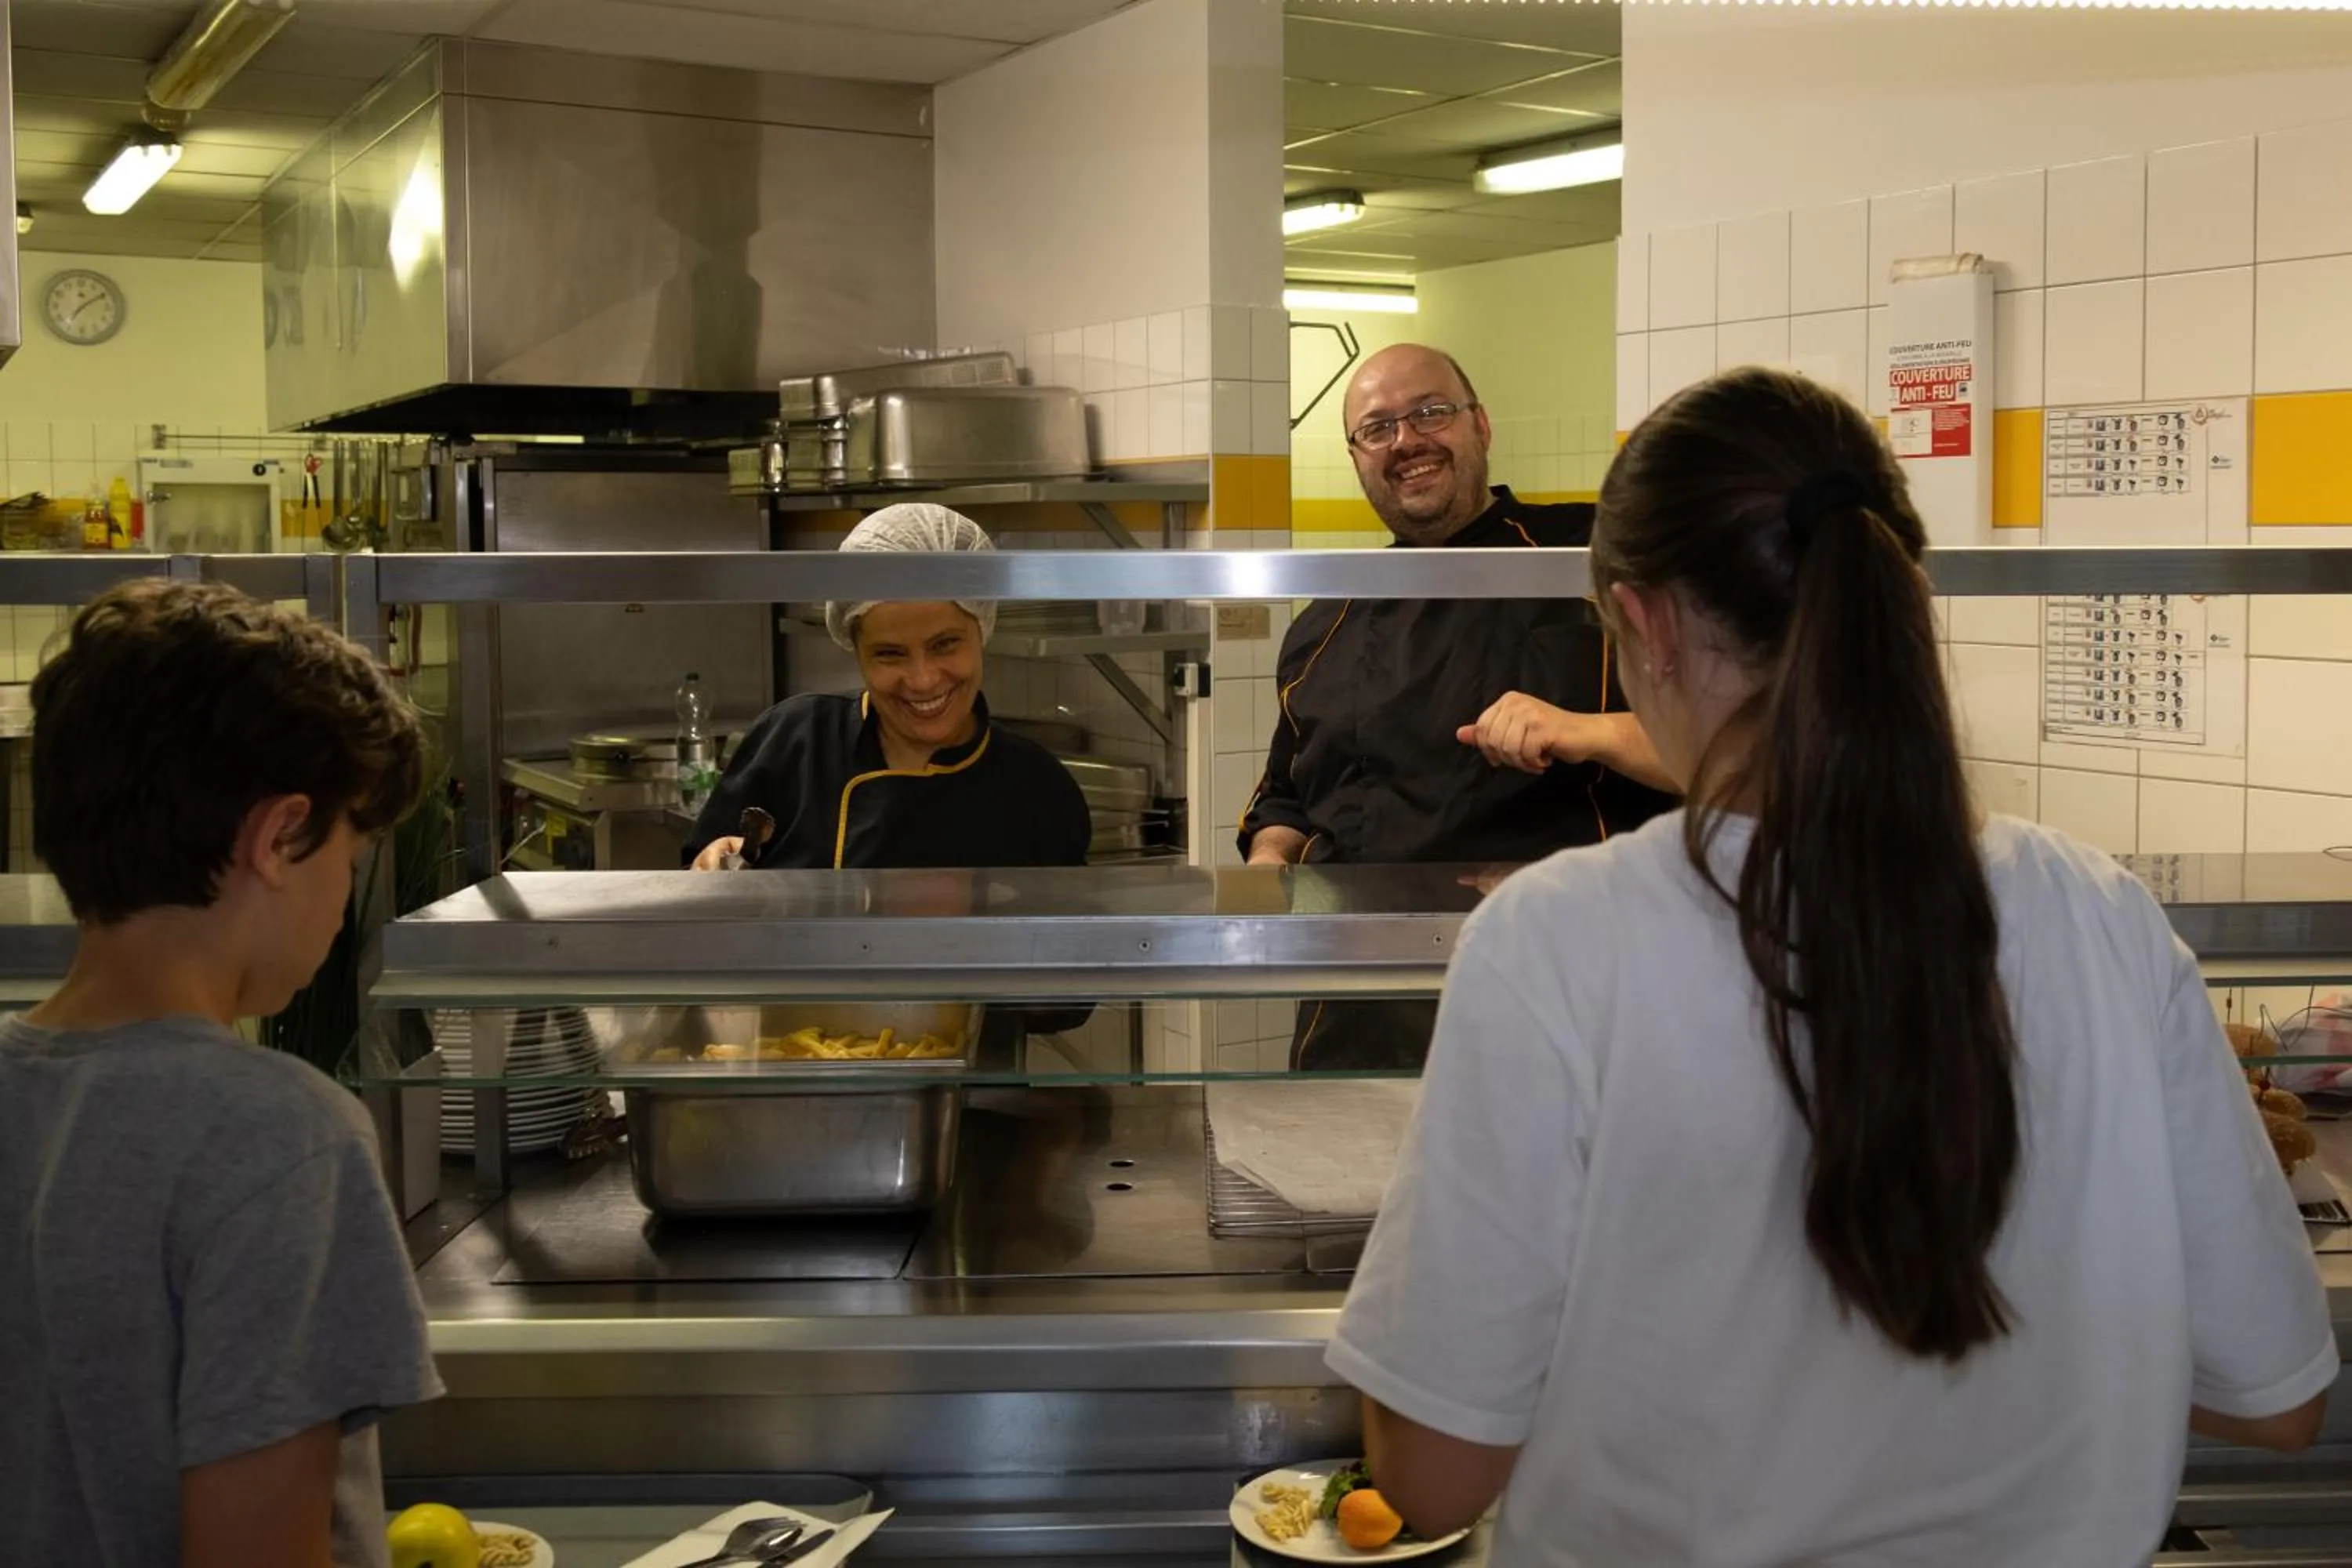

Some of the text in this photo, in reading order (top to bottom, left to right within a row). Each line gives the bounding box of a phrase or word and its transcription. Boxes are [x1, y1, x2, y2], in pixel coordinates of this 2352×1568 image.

[1889, 343, 1935, 355] COUVERTURE
[1936, 339, 1972, 350] ANTI-FEU
[1891, 366, 1970, 385] COUVERTURE
